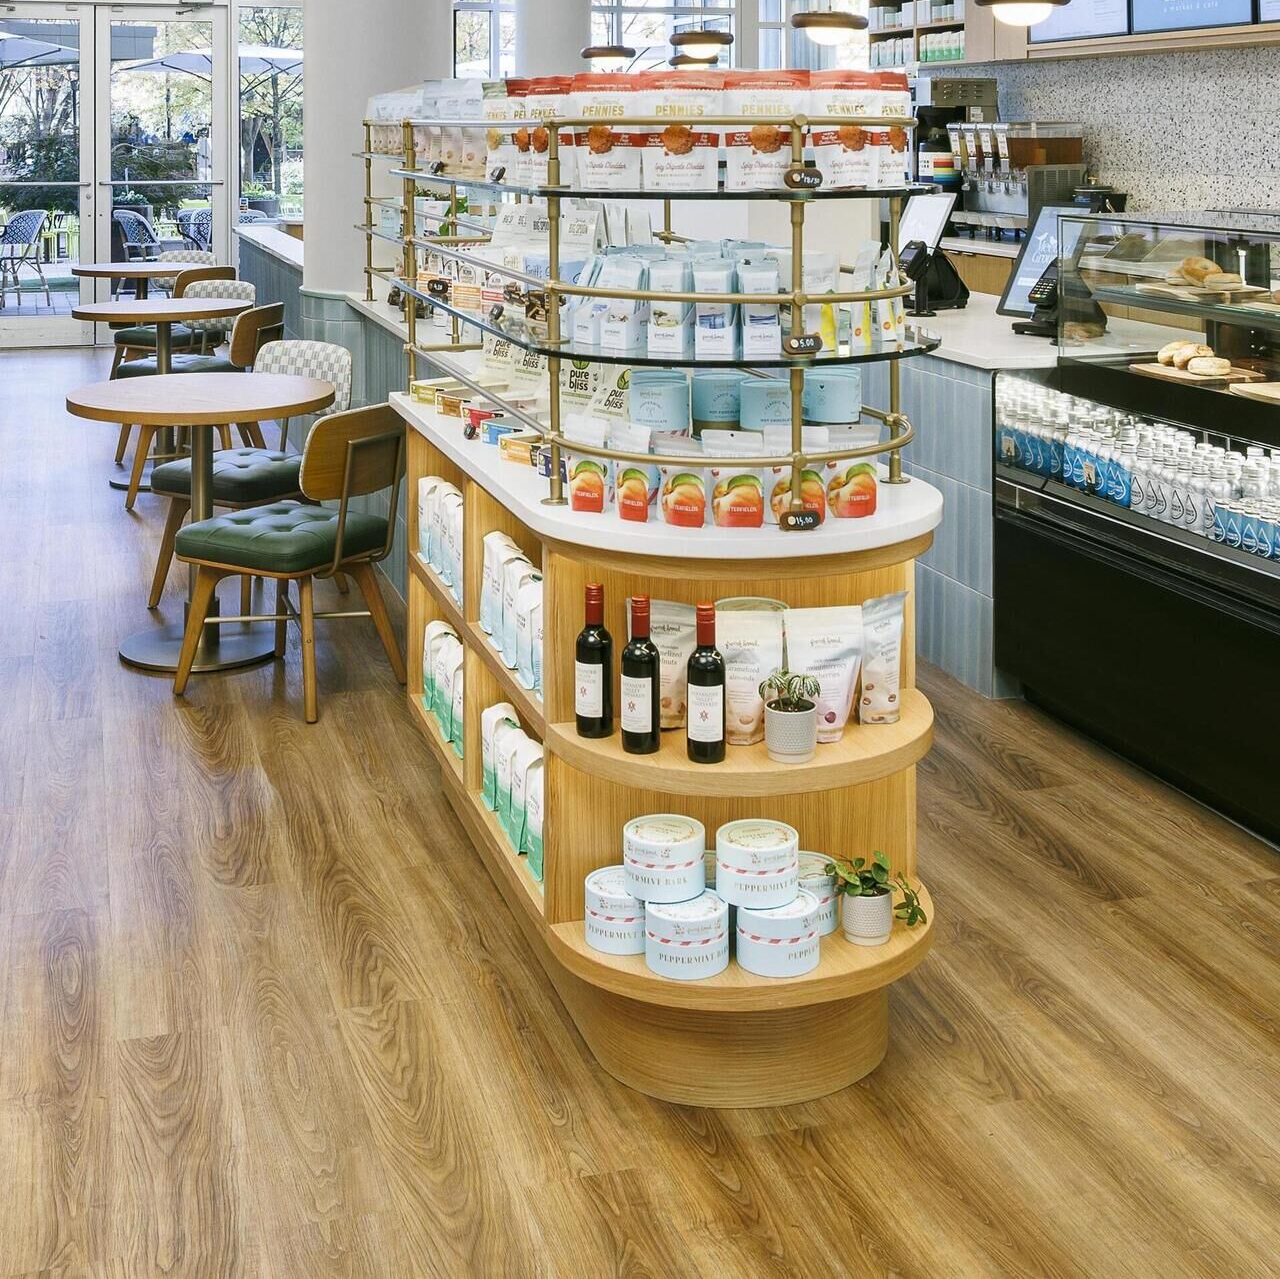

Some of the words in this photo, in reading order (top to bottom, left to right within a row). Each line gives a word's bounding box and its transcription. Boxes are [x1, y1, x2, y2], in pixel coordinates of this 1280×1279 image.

[582, 105, 625, 117] PENNIES
[655, 105, 704, 117] PENNIES
[741, 104, 792, 115] PENNIES
[826, 104, 867, 115] PENNIES
[881, 105, 906, 115] PENNIE
[495, 339, 512, 351] pure
[799, 338, 815, 348] 5.00
[492, 347, 509, 359] bliss
[522, 358, 539, 370] bliss
[569, 369, 590, 382] pure
[568, 378, 589, 392] bliss
[609, 388, 625, 401] pur
[603, 398, 624, 411] bliss
[727, 665, 760, 674] aramelized
[627, 872, 662, 886] PPERMINT
[665, 876, 688, 886] BARK
[734, 881, 788, 893] PEPPERMINT
[588, 923, 638, 939] PEPPERMINT
[658, 952, 716, 965] PEPPERMINT
